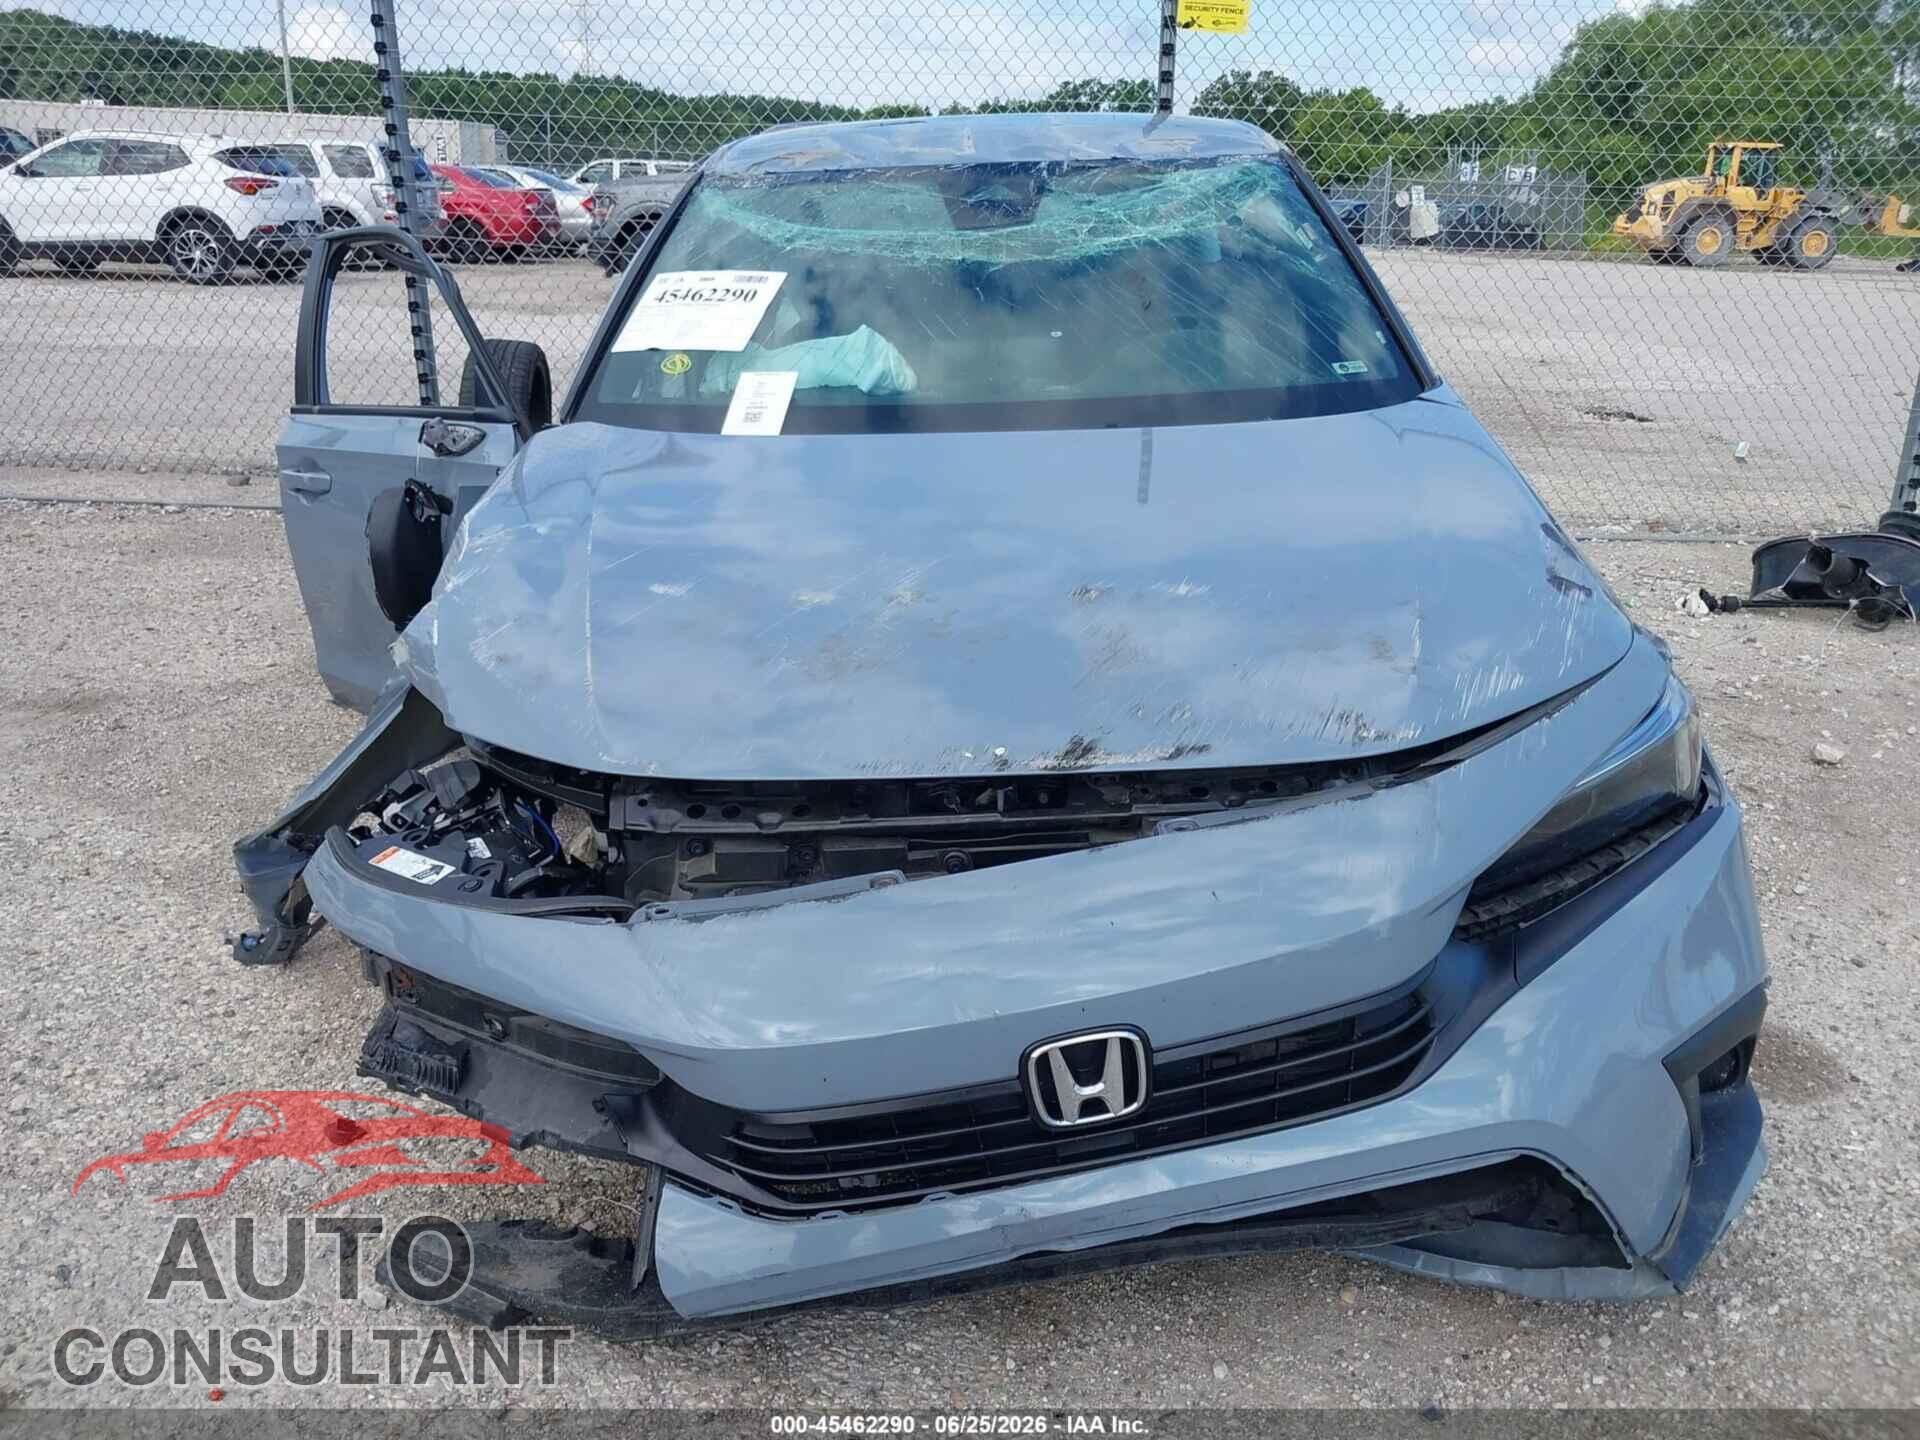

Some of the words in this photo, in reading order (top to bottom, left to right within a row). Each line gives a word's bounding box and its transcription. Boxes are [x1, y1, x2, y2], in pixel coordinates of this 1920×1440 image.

[1184, 4, 1220, 13] SECURITY
[1220, 7, 1244, 15] FENCE
[655, 287, 758, 303] 45462290
